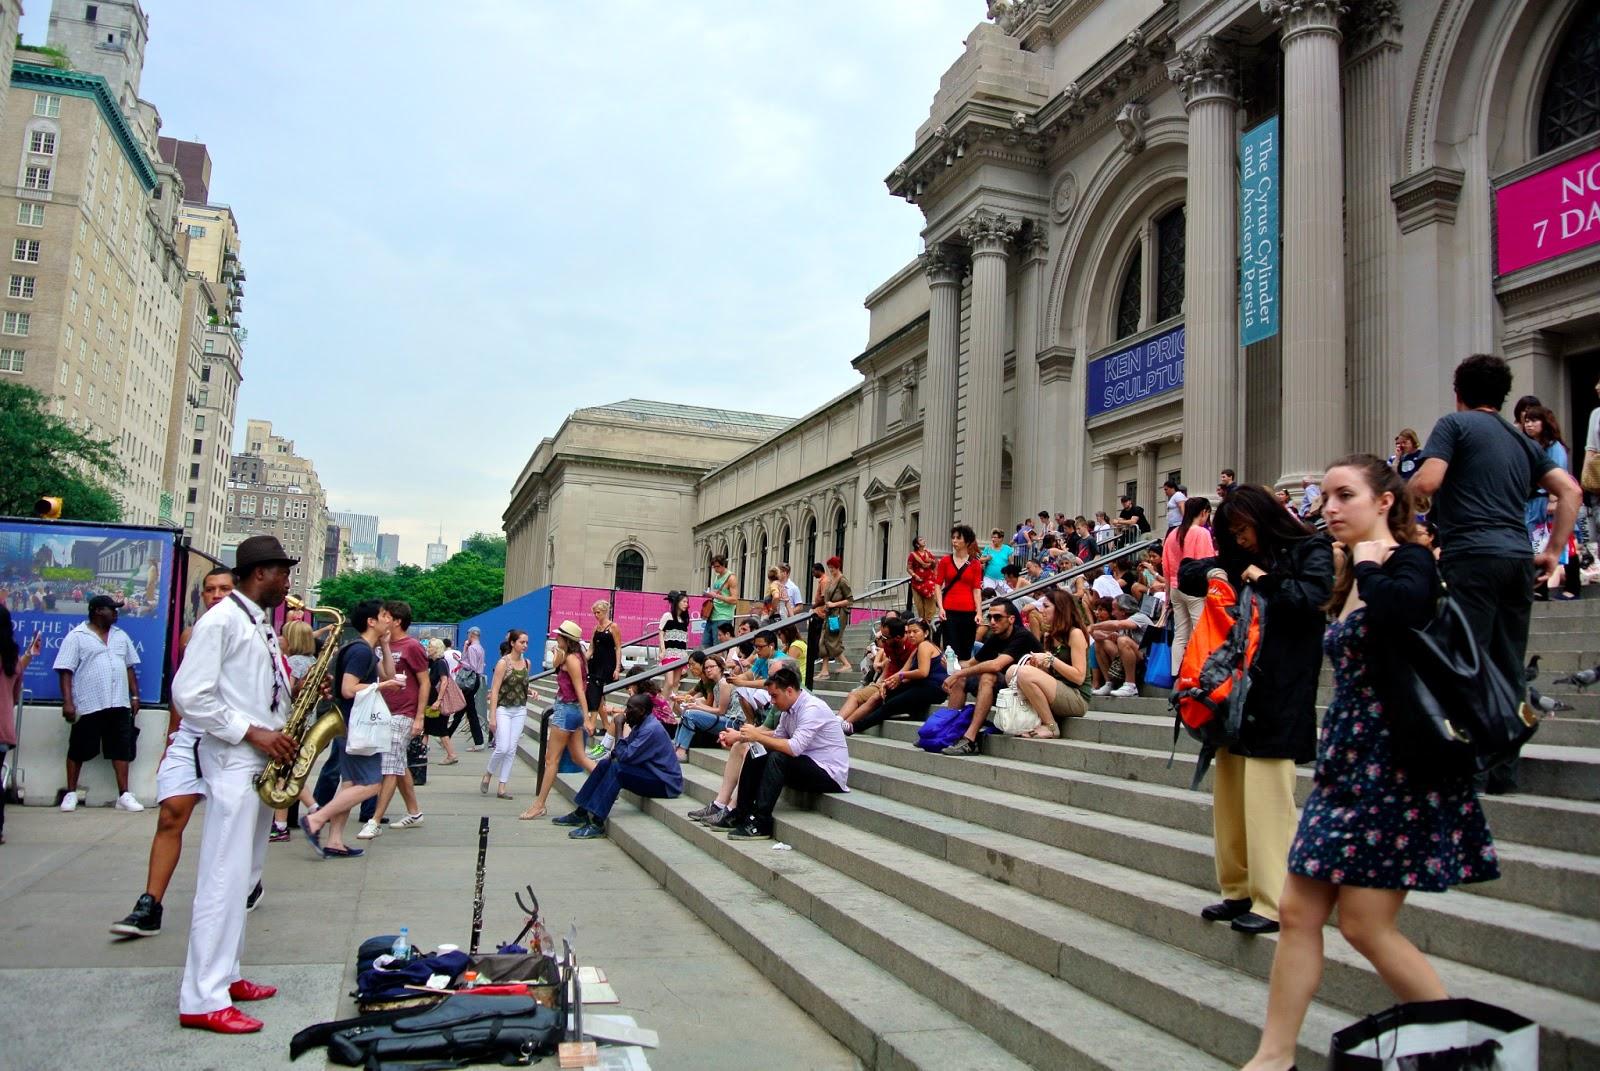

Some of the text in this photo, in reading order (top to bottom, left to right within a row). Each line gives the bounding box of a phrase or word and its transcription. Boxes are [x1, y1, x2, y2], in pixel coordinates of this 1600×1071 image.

[1244, 144, 1256, 328] and Ancient Persia
[1255, 132, 1273, 325] The Cyrus Cylinder
[1533, 219, 1549, 248] 7
[1104, 347, 1141, 383] KEN
[31, 620, 62, 634] THE
